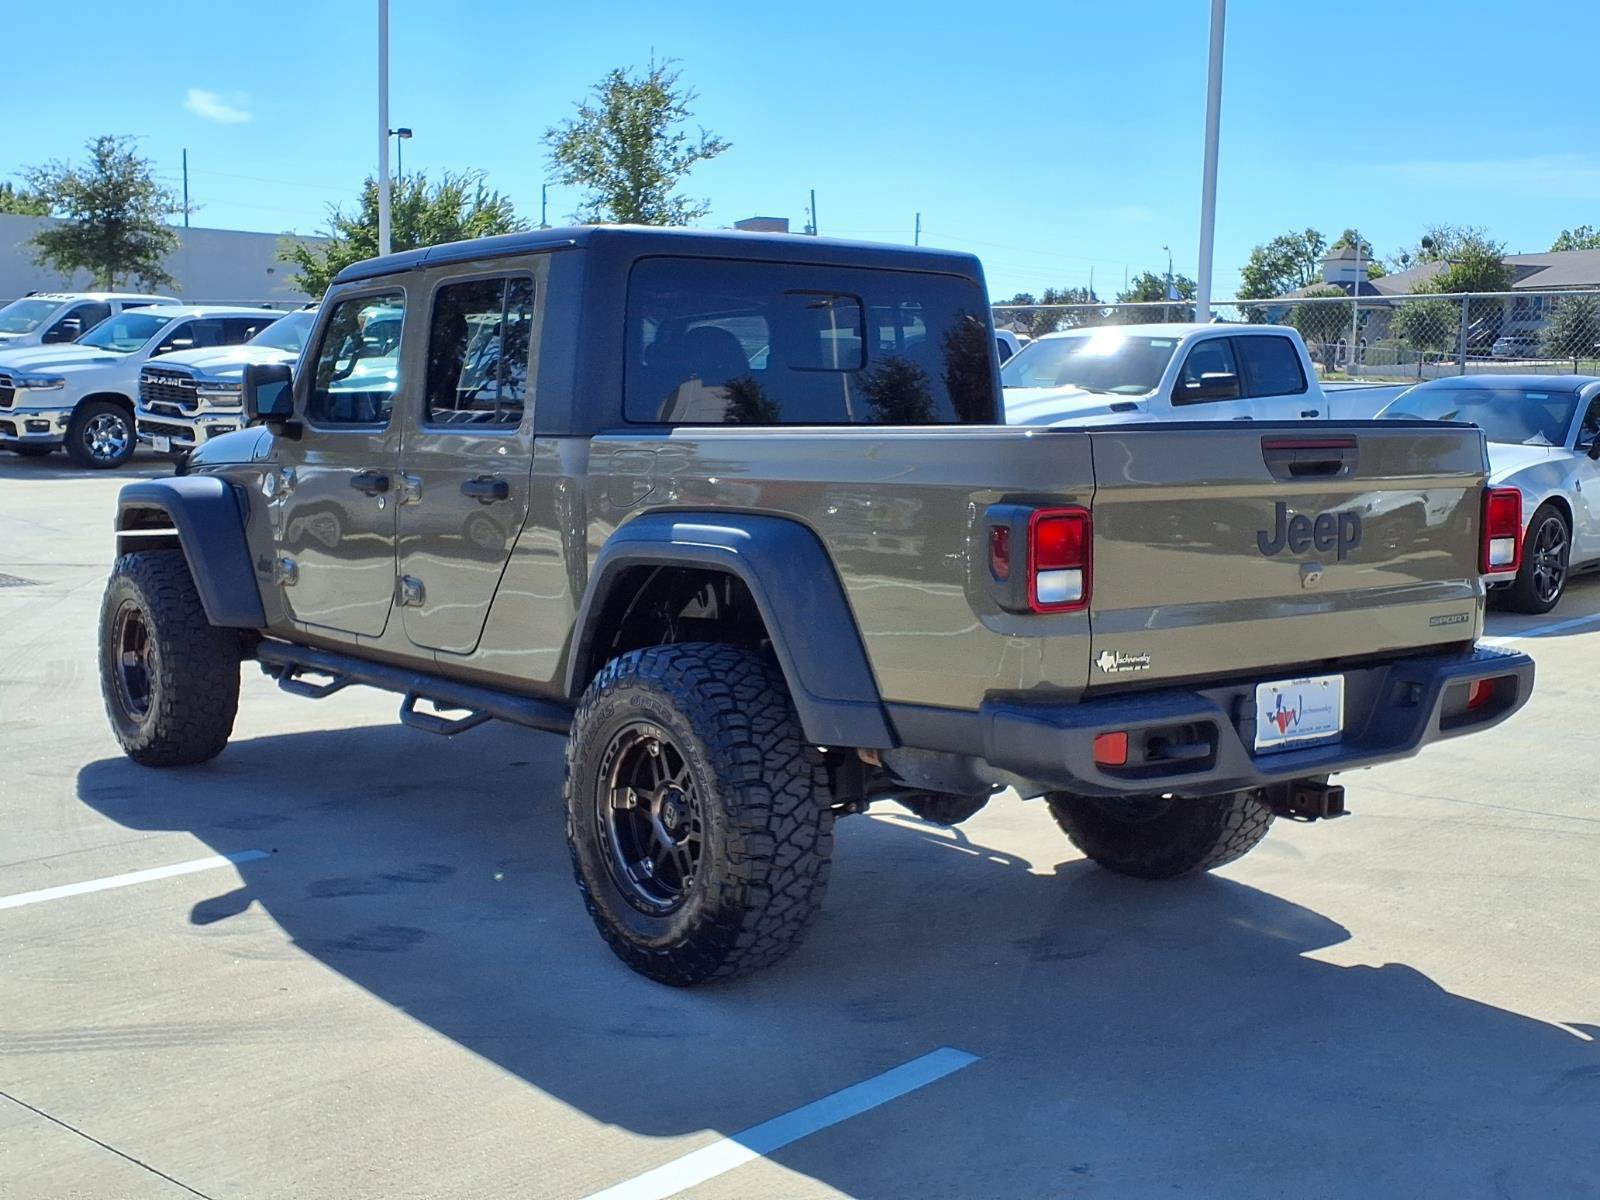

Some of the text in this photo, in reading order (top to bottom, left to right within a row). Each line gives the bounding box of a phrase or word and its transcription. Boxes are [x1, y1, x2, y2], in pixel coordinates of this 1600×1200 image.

[147, 375, 178, 386] RAM
[1257, 502, 1362, 561] Jeep
[1430, 613, 1469, 626] SPORT
